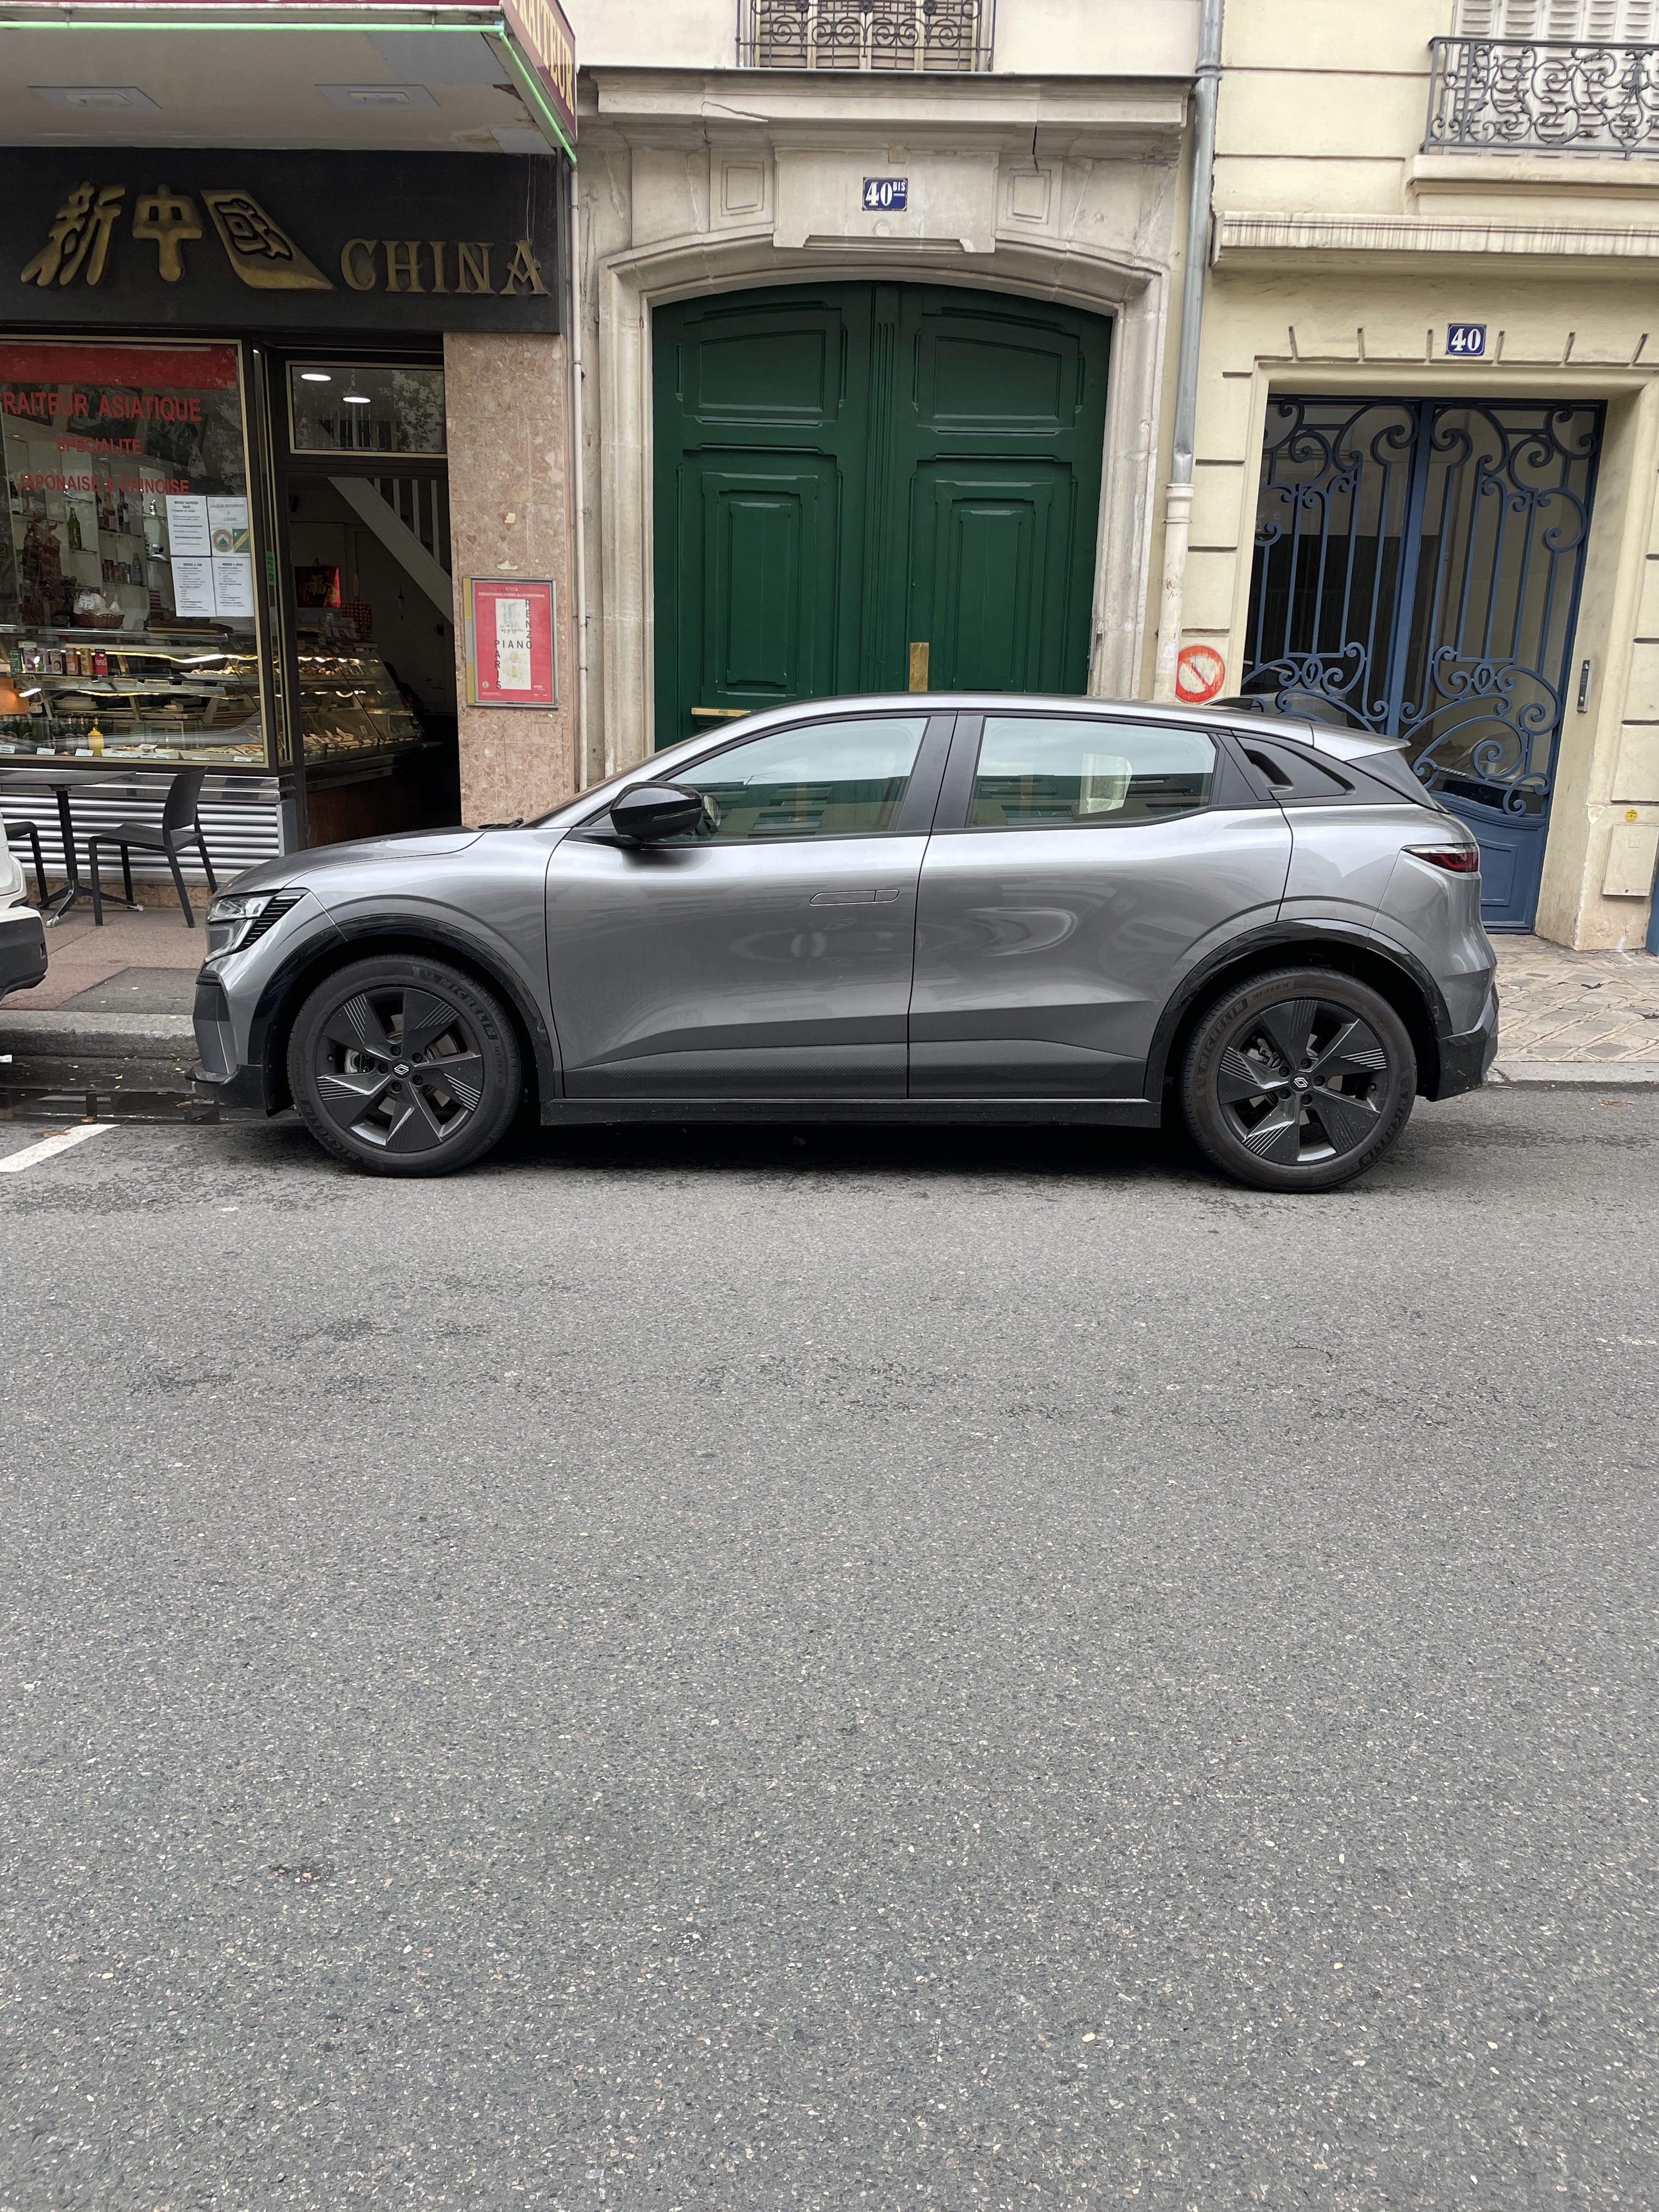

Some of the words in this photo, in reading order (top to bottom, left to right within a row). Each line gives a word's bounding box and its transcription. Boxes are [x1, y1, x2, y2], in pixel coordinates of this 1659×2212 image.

[510, 0, 574, 116] AITEUR
[865, 182, 893, 206] 40
[893, 181, 906, 191] BIS
[341, 238, 549, 296] CHINA
[1451, 328, 1481, 351] 40
[99, 394, 202, 422] ASIATIQUE
[17, 473, 99, 493] JAPONAISE
[119, 477, 190, 495] CHINOISE
[494, 640, 533, 649] PIANO
[438, 977, 496, 1037] MICHELIN
[1199, 998, 1247, 1069] MICHELIN
[1360, 1097, 1407, 1167] MICHELIN
